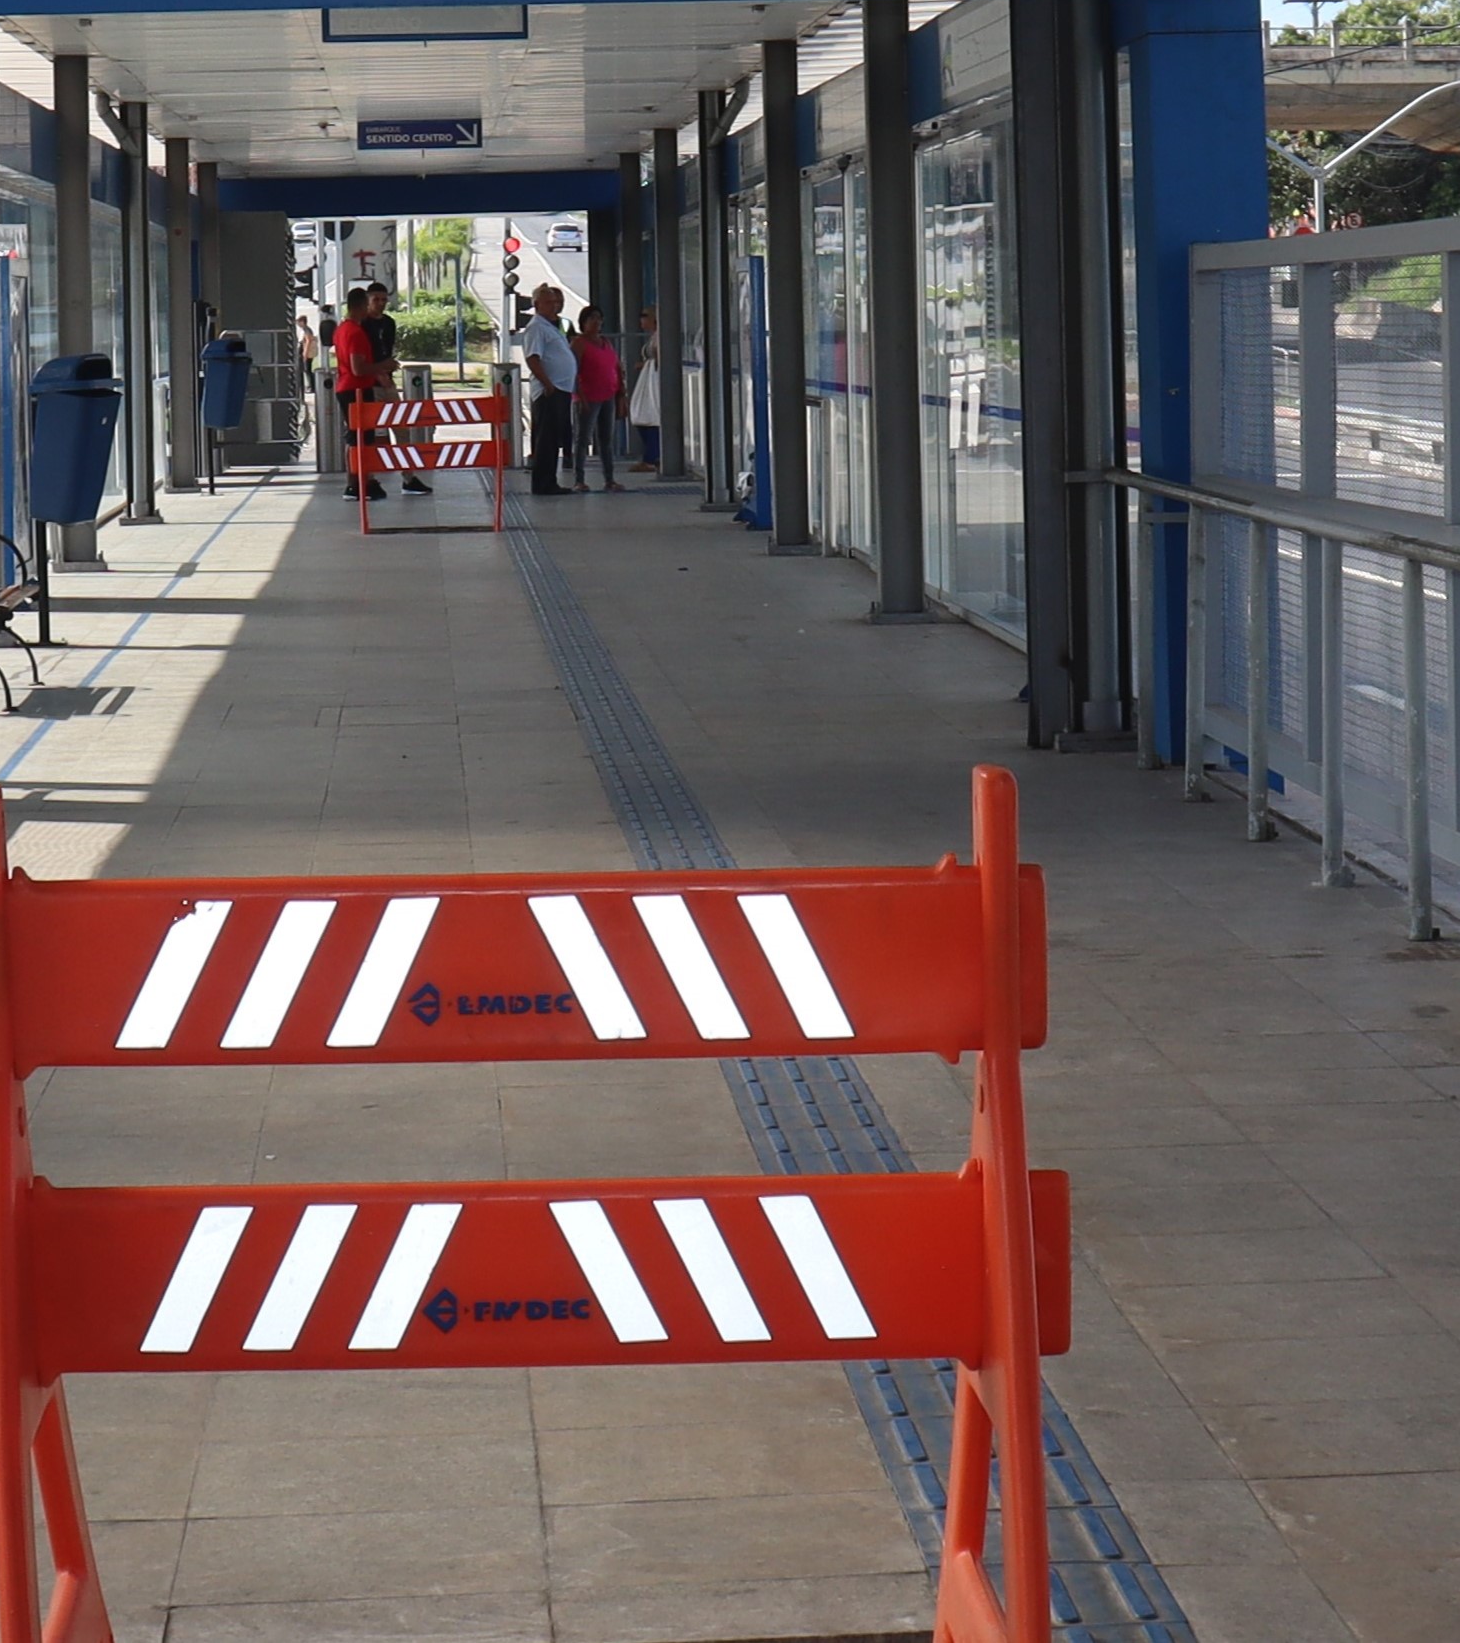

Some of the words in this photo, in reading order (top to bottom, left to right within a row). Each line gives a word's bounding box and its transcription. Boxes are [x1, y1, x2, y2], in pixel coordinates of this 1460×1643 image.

[365, 134, 410, 144] SENTIDO
[412, 133, 453, 143] CENTRO
[457, 993, 574, 1015] EMDEC
